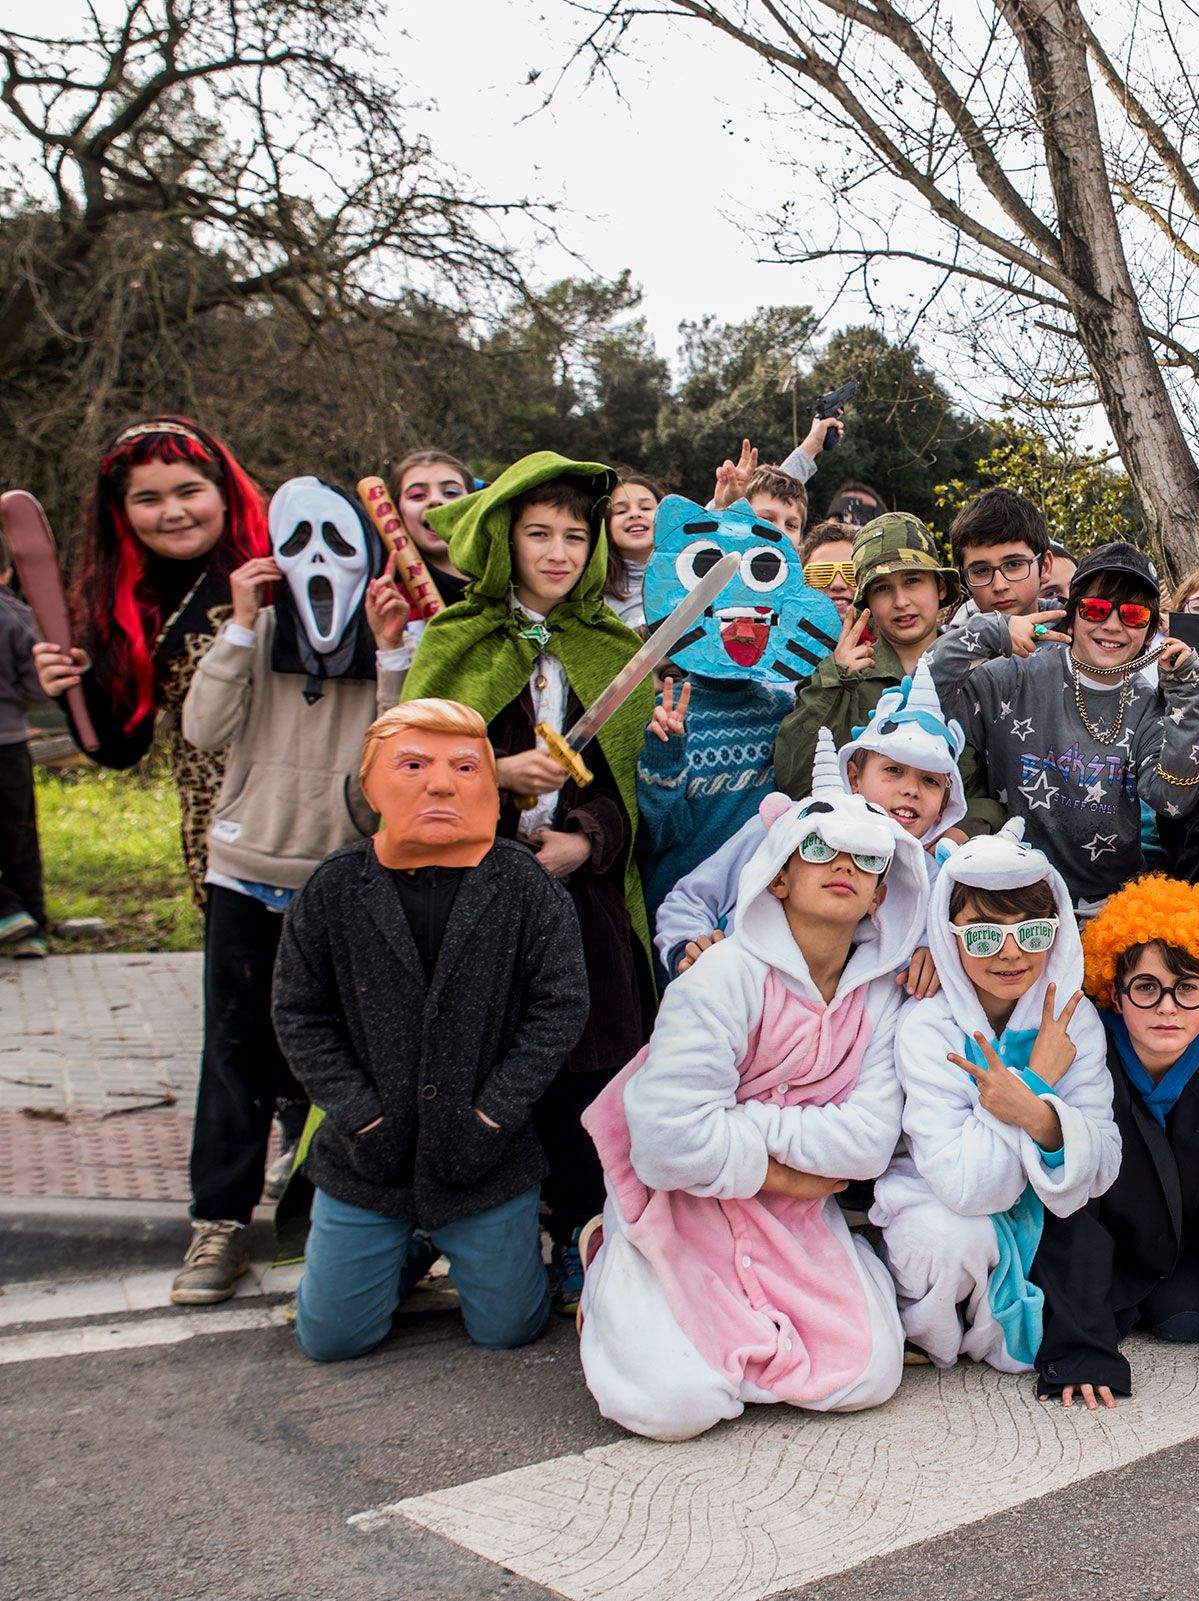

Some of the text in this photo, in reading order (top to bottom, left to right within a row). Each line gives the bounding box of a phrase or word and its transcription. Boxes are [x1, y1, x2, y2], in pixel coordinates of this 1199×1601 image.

[368, 485, 408, 550] GOOD
[1053, 793, 1117, 815] STAFF ONLY
[965, 928, 1001, 951] Perrier
[1018, 923, 1052, 944] Perrier
